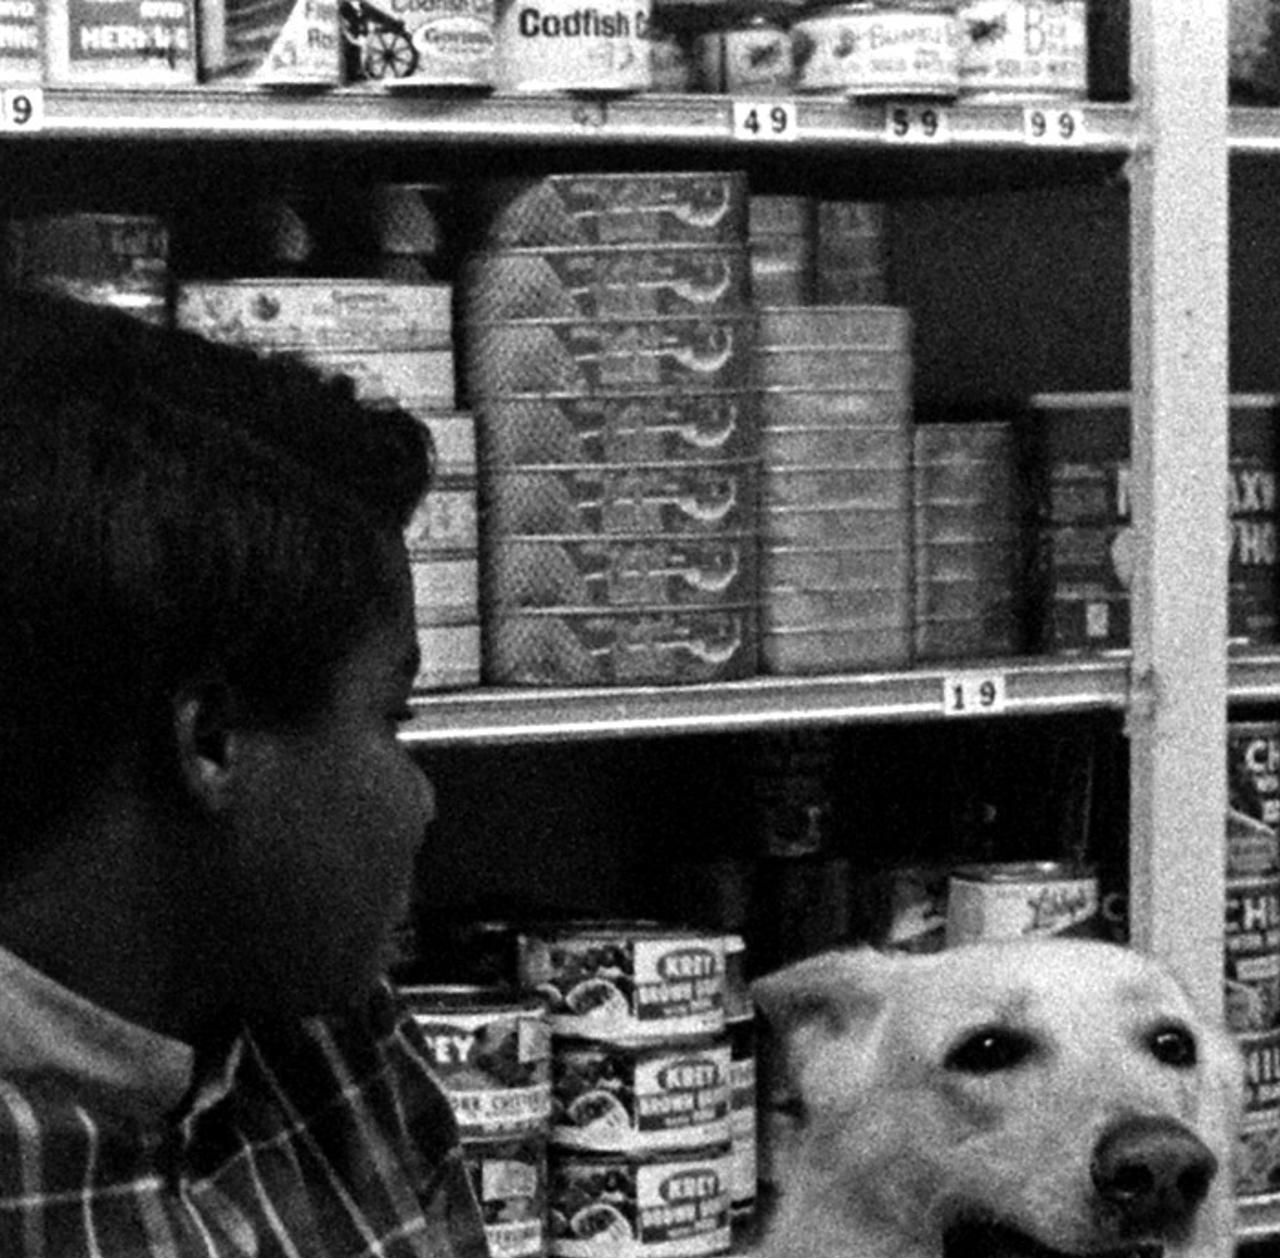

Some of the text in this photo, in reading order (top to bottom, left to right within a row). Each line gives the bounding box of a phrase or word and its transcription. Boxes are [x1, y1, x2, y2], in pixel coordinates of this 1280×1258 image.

[518, 7, 630, 38] Codfish
[744, 106, 789, 135] 49
[951, 679, 996, 711] 19
